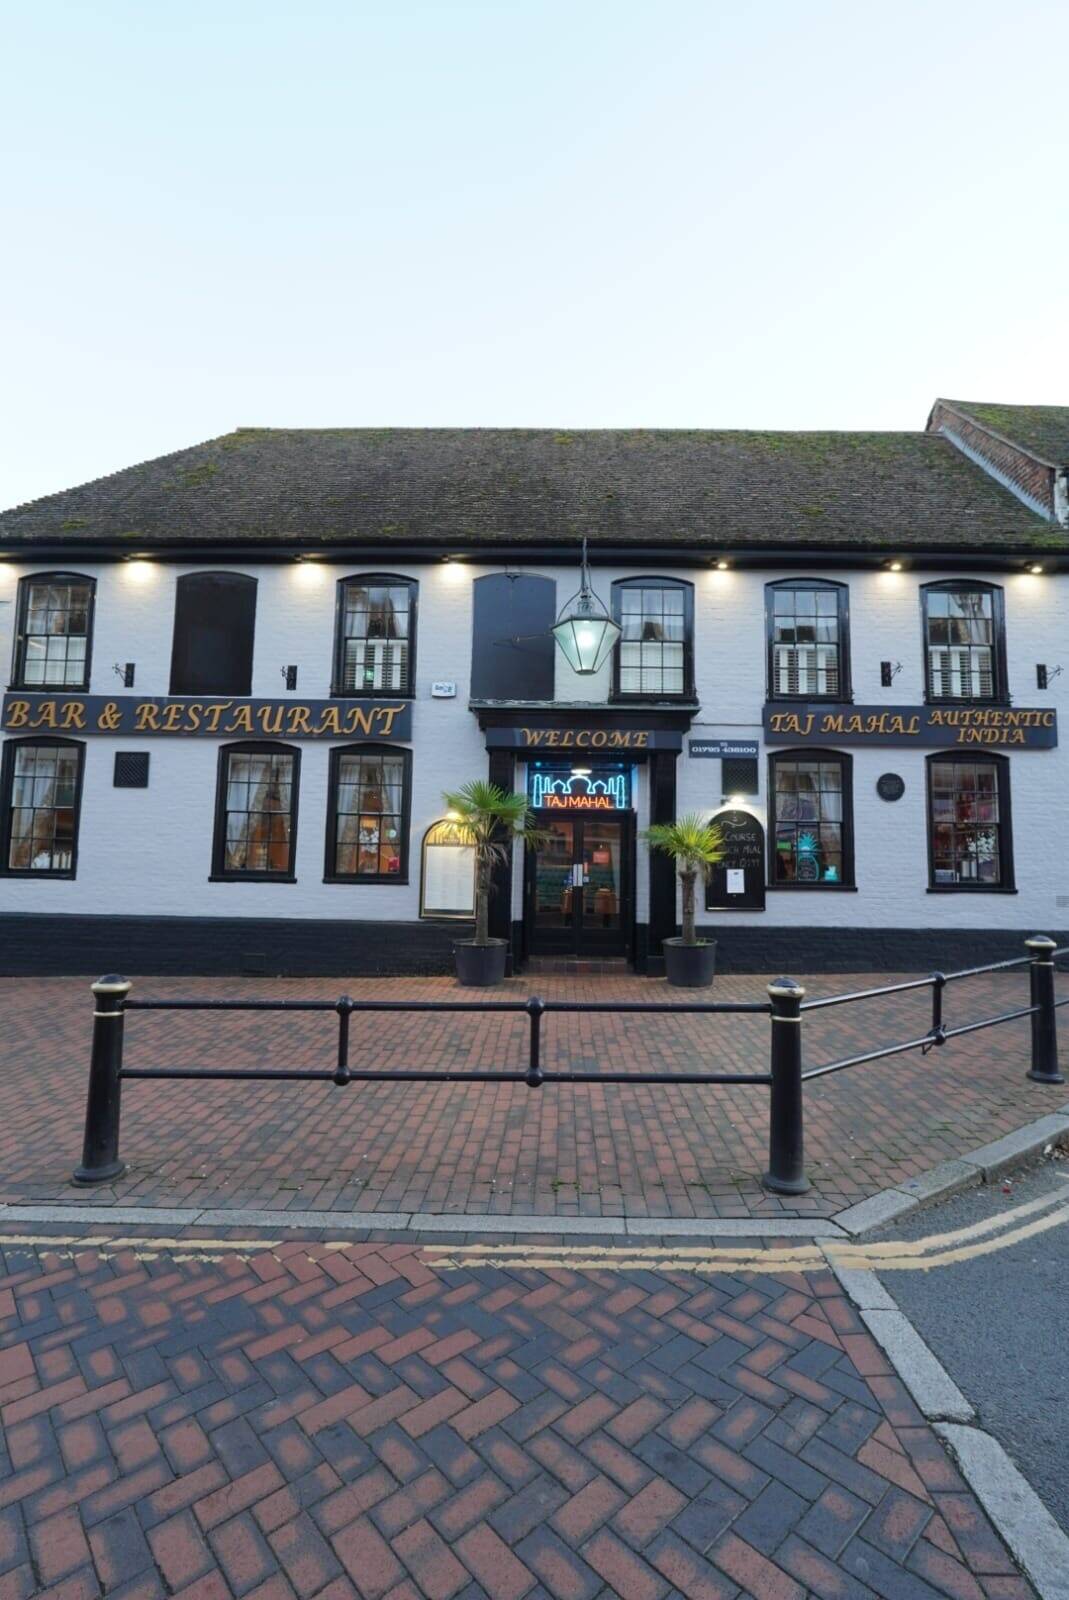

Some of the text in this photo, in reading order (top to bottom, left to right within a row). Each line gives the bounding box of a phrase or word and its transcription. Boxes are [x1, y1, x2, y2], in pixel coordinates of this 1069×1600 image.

[6, 700, 406, 736] BAR & RESTAURANT
[770, 712, 920, 736] TAJ MAHAL
[927, 709, 1055, 728] AUTHENTIC
[521, 728, 649, 748] WELCOME
[957, 727, 1026, 744] INDIA
[544, 795, 614, 809] TAJ MAHAL
